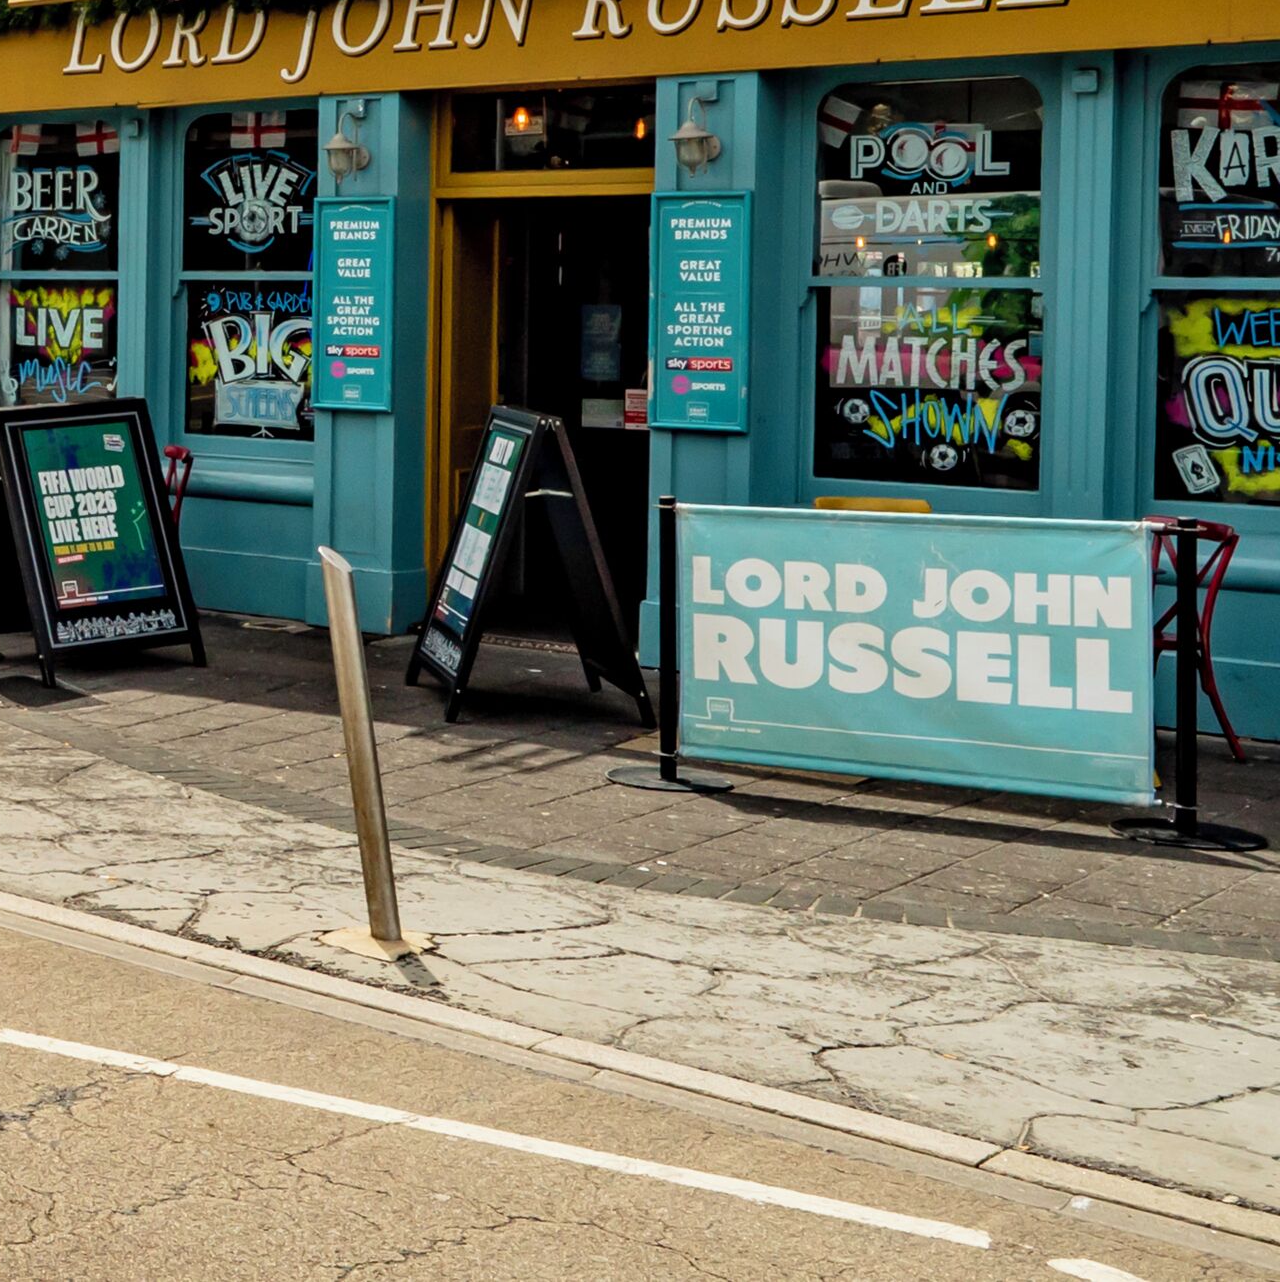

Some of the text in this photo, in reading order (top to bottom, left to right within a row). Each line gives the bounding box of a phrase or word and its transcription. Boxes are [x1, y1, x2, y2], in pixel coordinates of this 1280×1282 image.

[850, 126, 1010, 180] POOL
[218, 163, 299, 207] LIVE
[909, 181, 948, 196] AND
[11, 169, 112, 222] BEER
[208, 205, 303, 236] SPORT
[874, 199, 992, 234] DARTS
[329, 221, 380, 230] PREMIUM
[670, 218, 732, 228] PREMIUM
[1184, 222, 1216, 234] EVERY
[13, 217, 98, 245] GARDEN
[333, 231, 377, 241] BRANDS
[674, 229, 728, 240] BRANDS
[337, 258, 372, 267] GREAT
[679, 259, 722, 270] GREAT
[337, 268, 371, 278] VALUE
[679, 271, 721, 282] VALUE
[225, 292, 253, 312] PUB
[332, 295, 375, 305] ALL THE
[336, 305, 371, 315] GREAT
[674, 301, 726, 312] ALL THE
[326, 316, 380, 326] SPORTING
[679, 313, 721, 324] GREAT
[899, 301, 971, 335] ALL
[15, 307, 104, 349] LIVE
[332, 327, 374, 336] ACTION
[666, 324, 733, 336] SPORTING
[674, 336, 725, 347] ACTION
[208, 313, 313, 384] BIG
[326, 345, 379, 357] sky sports
[667, 358, 731, 371] sky sports
[836, 334, 1027, 392] MATCHES
[346, 367, 375, 376] SPORTS
[690, 382, 726, 392] SPORTS
[863, 389, 1009, 454] SHOWN
[1242, 445, 1280, 474] NI
[38, 465, 125, 495] FIFA WORLD
[43, 490, 118, 519] CUP 2026
[48, 514, 119, 544] LIVE HERE
[692, 555, 1132, 629] LORD JOHN
[693, 613, 1133, 714] RUSSELL
